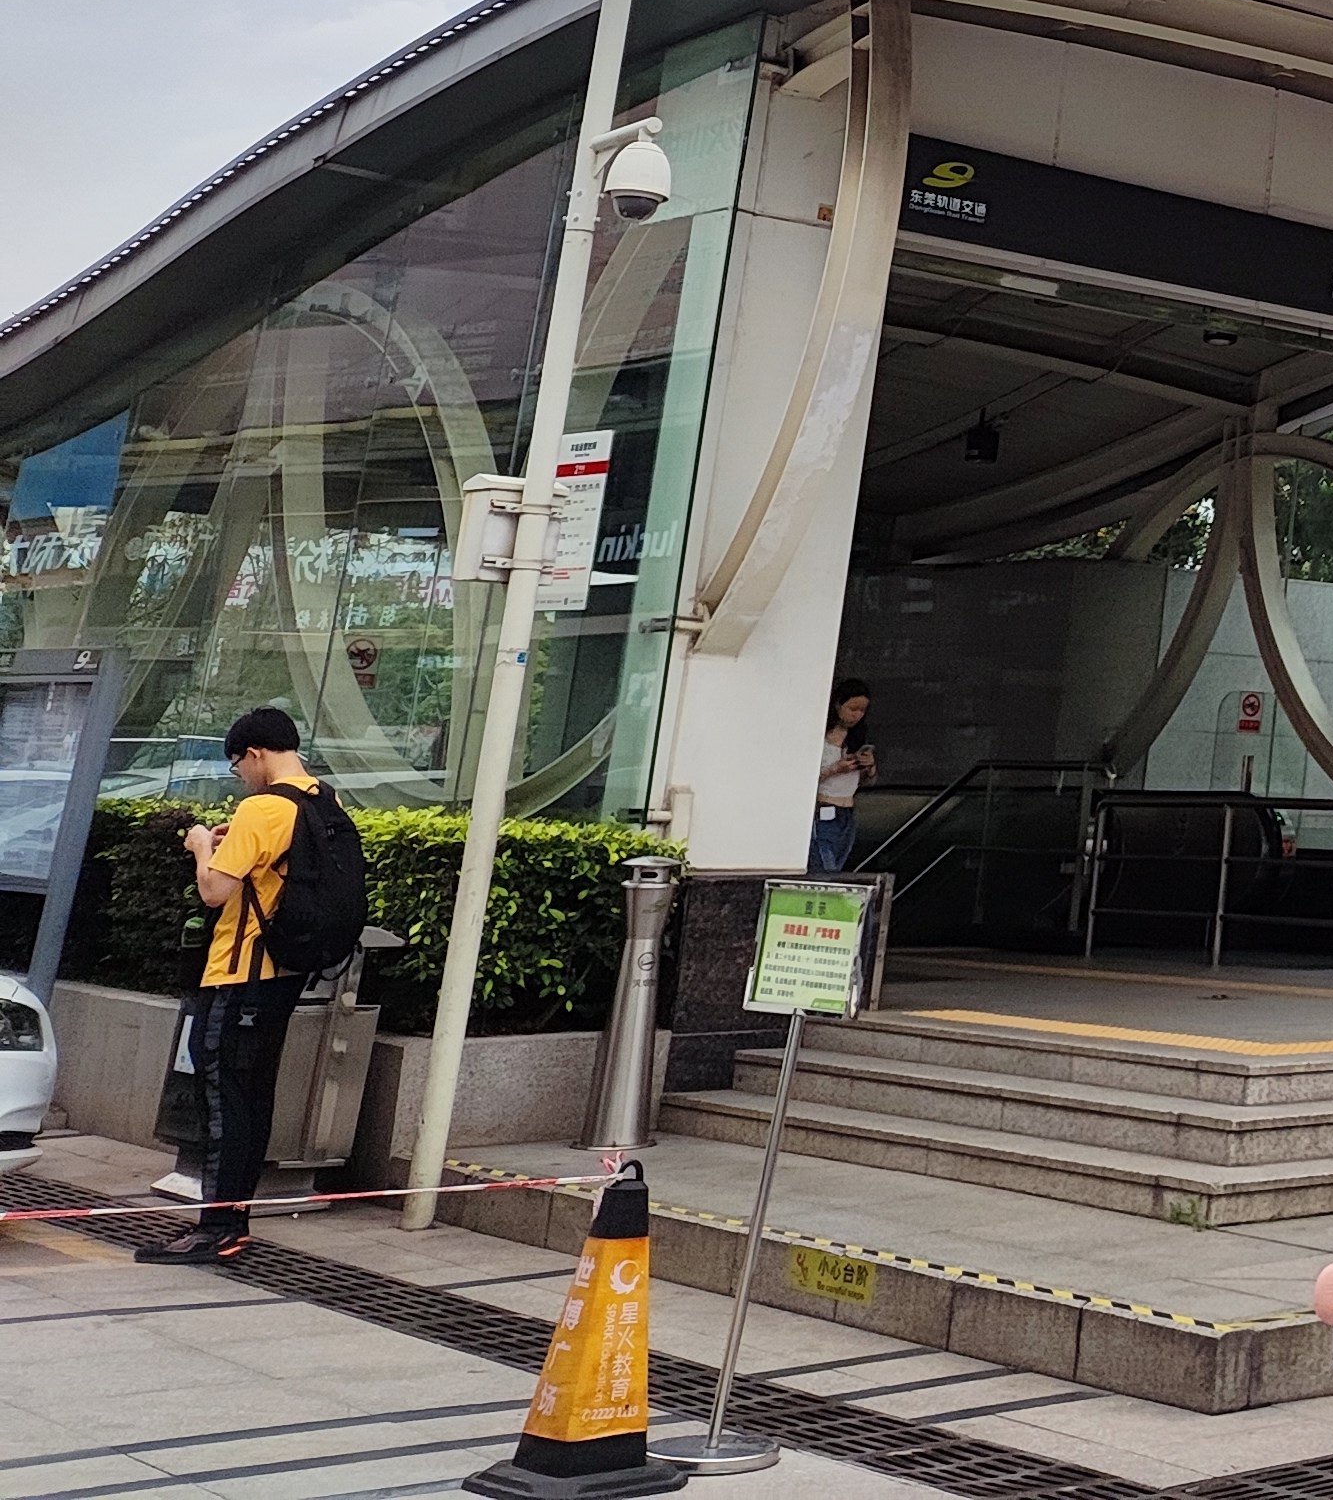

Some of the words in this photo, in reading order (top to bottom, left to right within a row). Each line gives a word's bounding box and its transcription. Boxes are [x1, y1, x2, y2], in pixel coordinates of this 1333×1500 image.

[909, 189, 987, 217] 东莞轨道交通
[818, 1256, 868, 1288] 小心台阶
[537, 1255, 596, 1416] 世博广场
[603, 1303, 618, 1341] SPARK
[594, 1342, 613, 1403] Education
[610, 1301, 639, 1401] 星火教育
